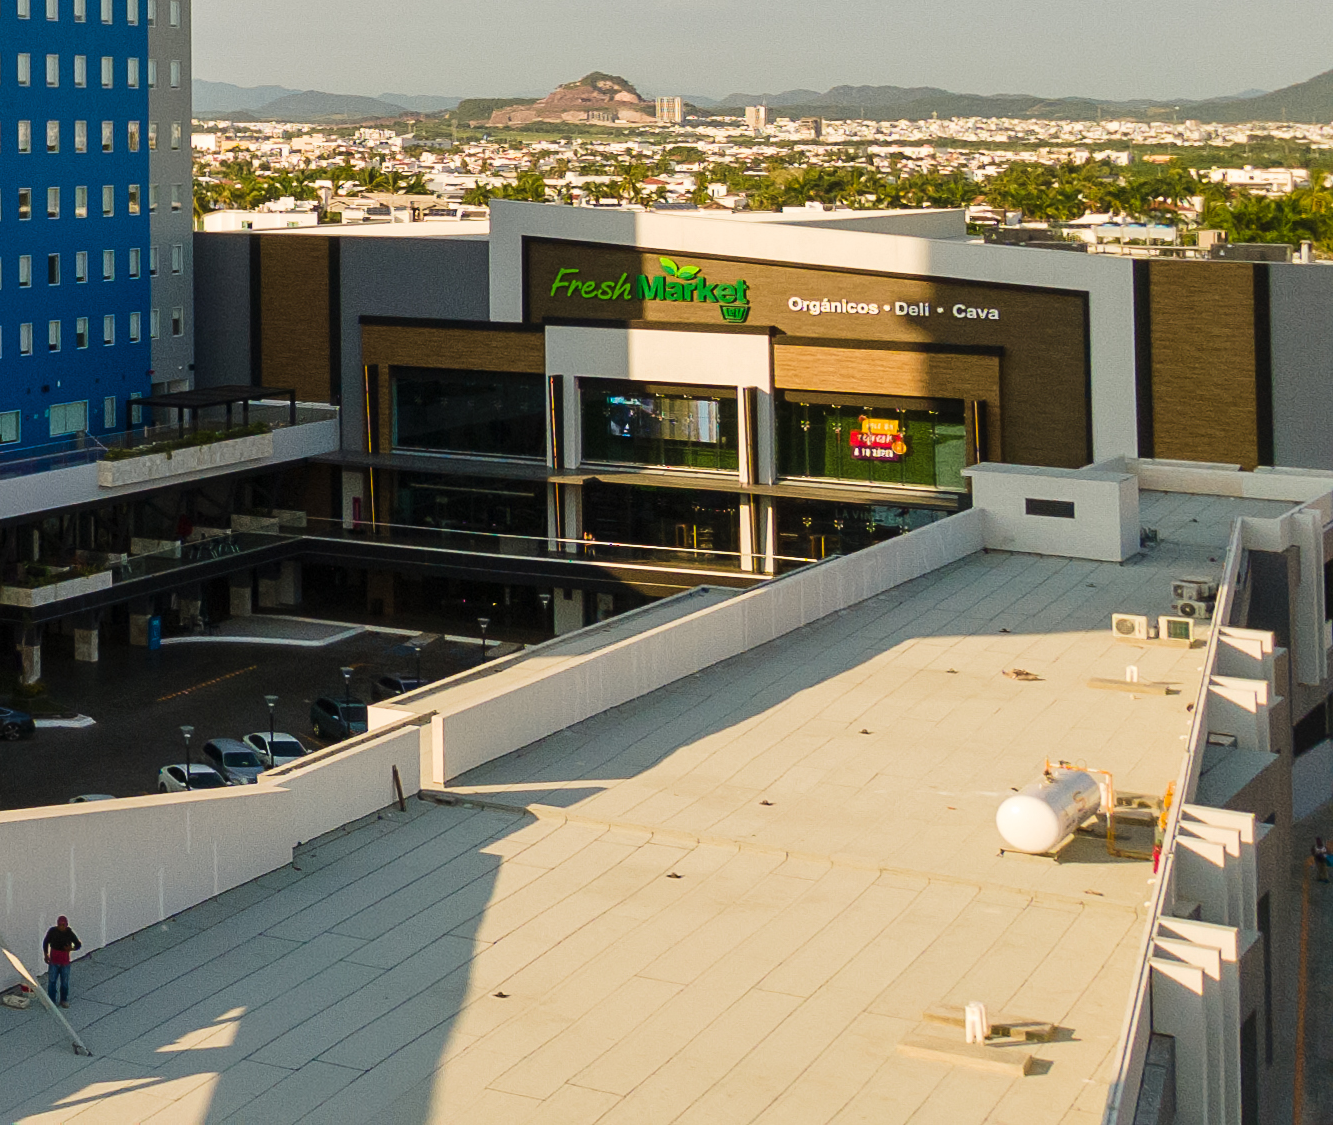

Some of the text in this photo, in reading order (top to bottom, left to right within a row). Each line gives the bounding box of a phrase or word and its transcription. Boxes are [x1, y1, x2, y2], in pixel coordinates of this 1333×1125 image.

[550, 267, 749, 304] Fresh Market
[788, 296, 1000, 320] Orgánicos Deli Cava
